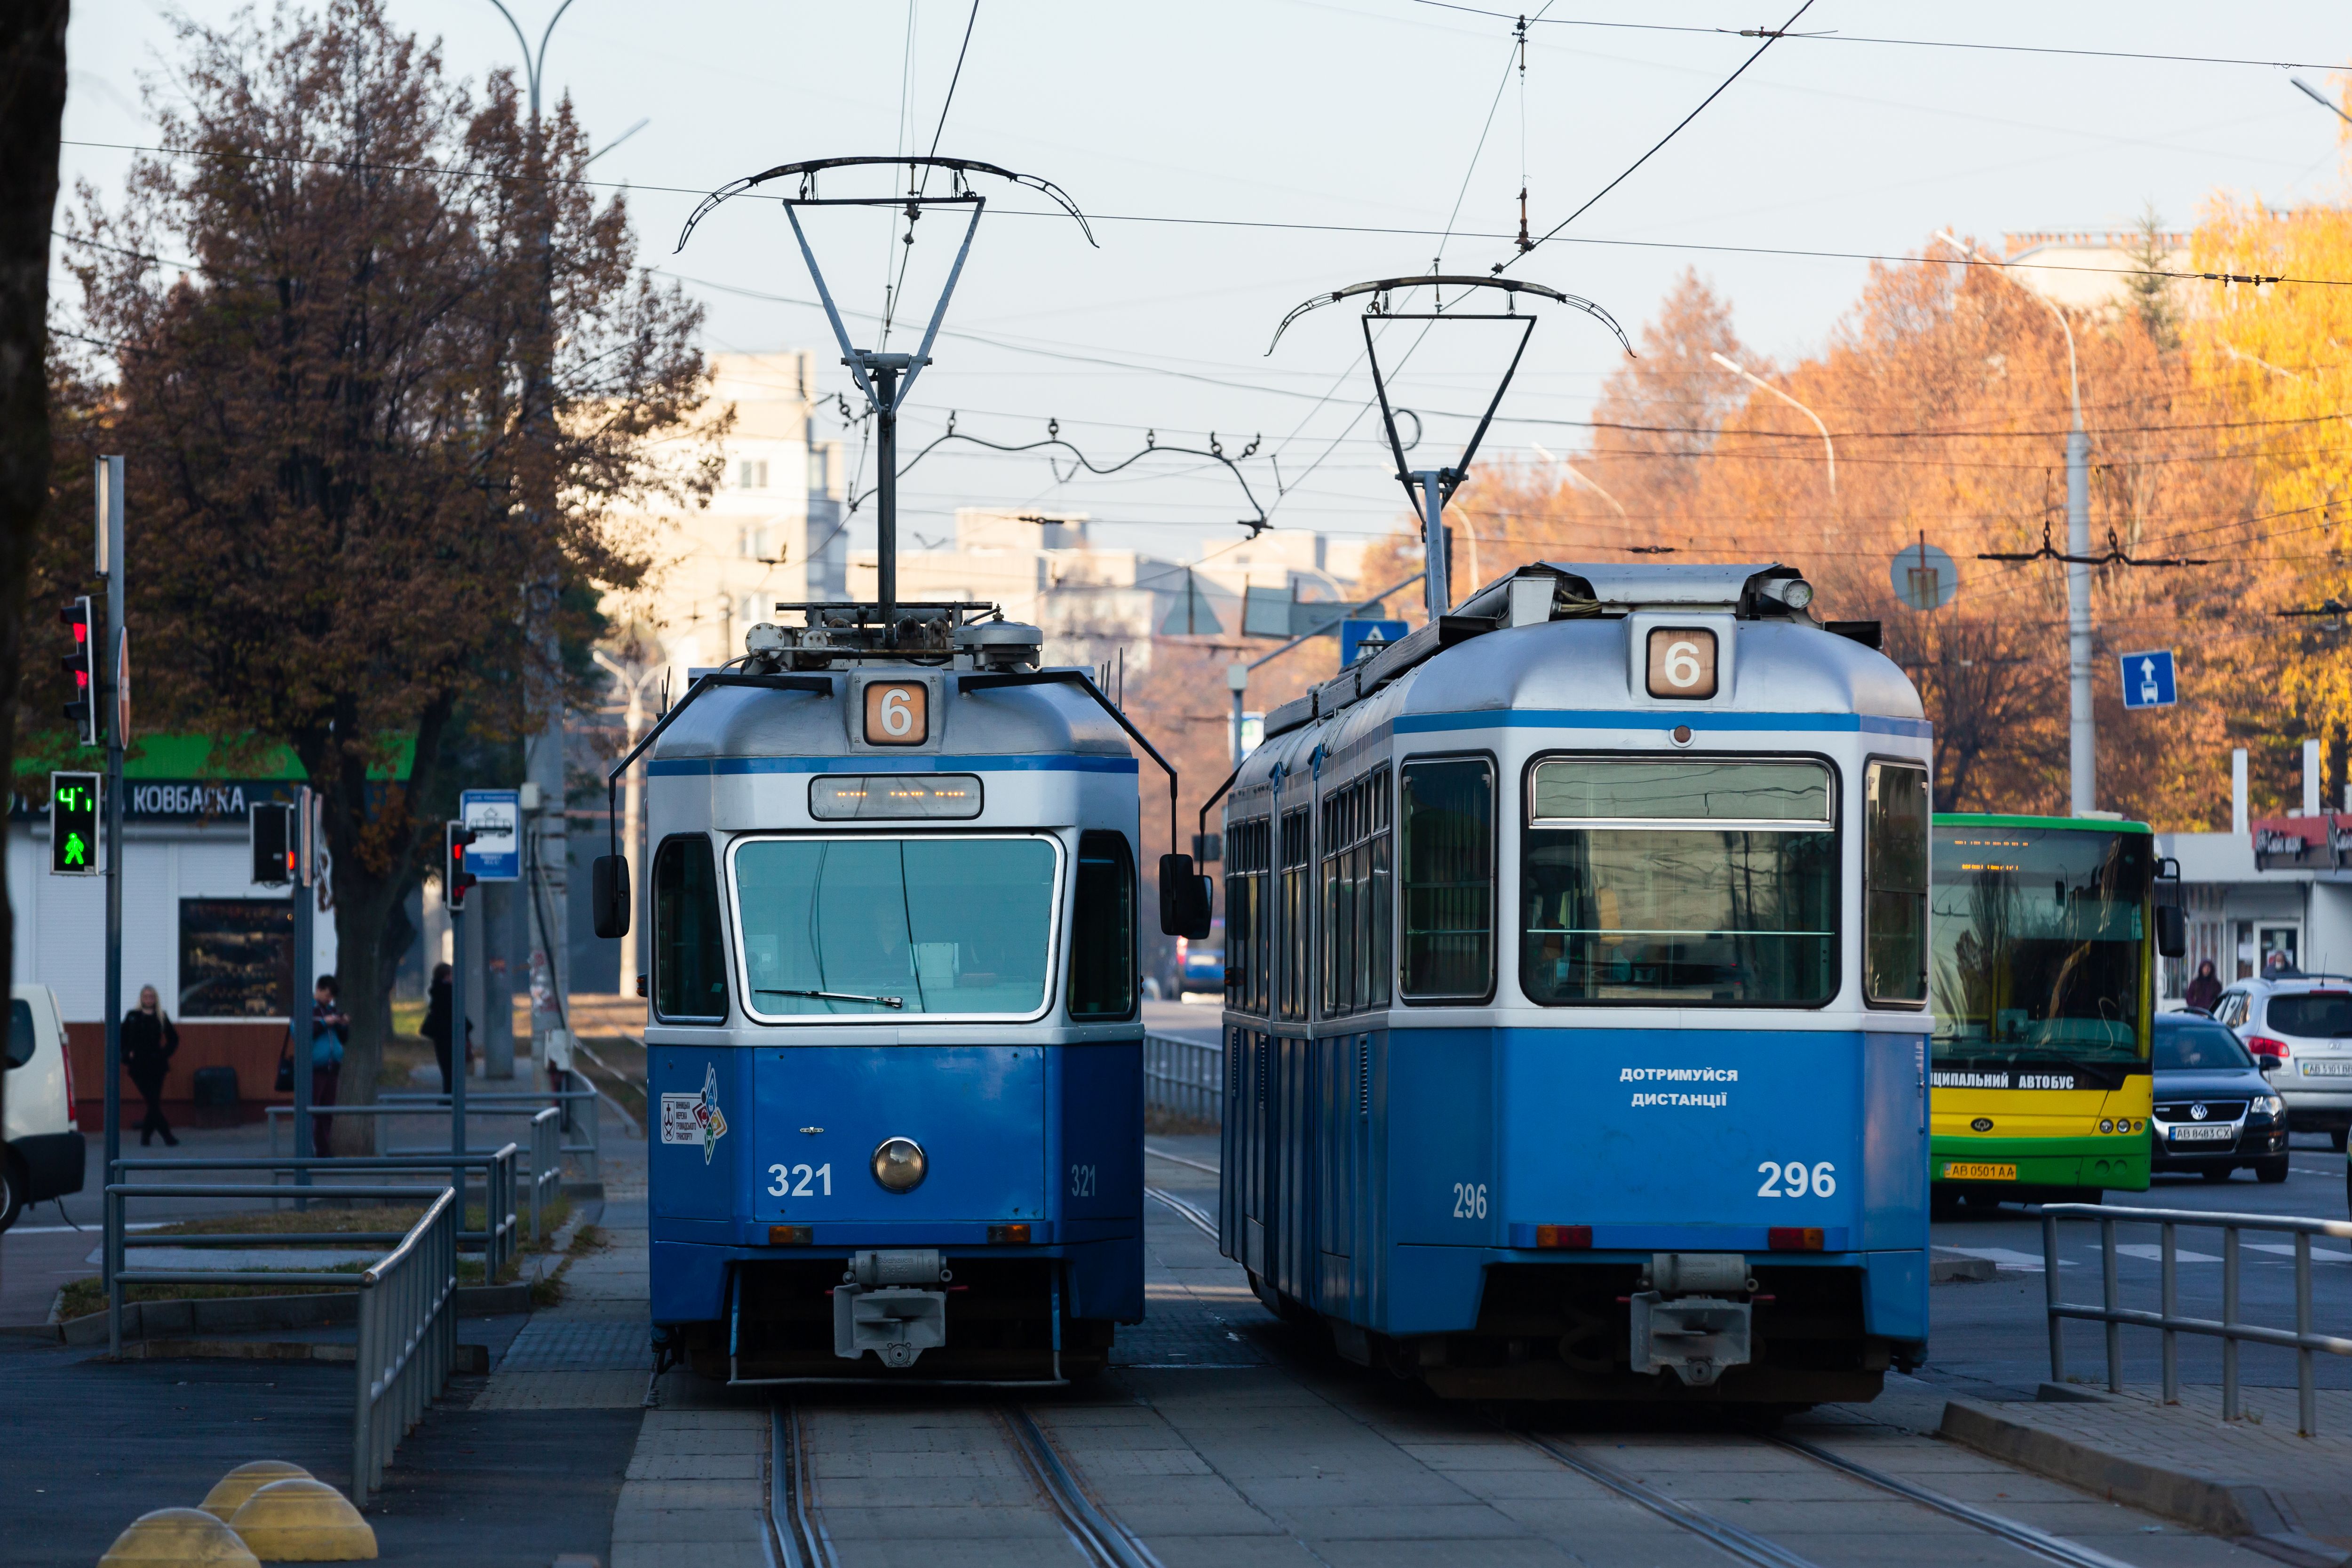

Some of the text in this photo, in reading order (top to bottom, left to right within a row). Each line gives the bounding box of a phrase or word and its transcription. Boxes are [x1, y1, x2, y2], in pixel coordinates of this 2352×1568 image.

[1664, 641, 1701, 688] 6
[880, 688, 913, 737] 6
[134, 786, 245, 813] КОВБАСКА
[1619, 1067, 1738, 1082] ДОТРИМУЙСЯ
[2018, 1075, 2074, 1089] АВТОБУС
[1631, 1091, 1727, 1108] ДИСТАНЦІЇ
[675, 1122, 697, 1131] ГРОМАДСЬКОГО
[676, 1132, 693, 1141] ТРАНСПОРТУ
[2177, 1129, 2190, 1138] AB
[2217, 1128, 2230, 1138] CX
[766, 1162, 832, 1197] 321
[1071, 1163, 1096, 1197] 321
[1757, 1161, 1837, 1199] 296
[1953, 1165, 2015, 1177] AB 0501 AA
[1453, 1182, 1487, 1220] 296
